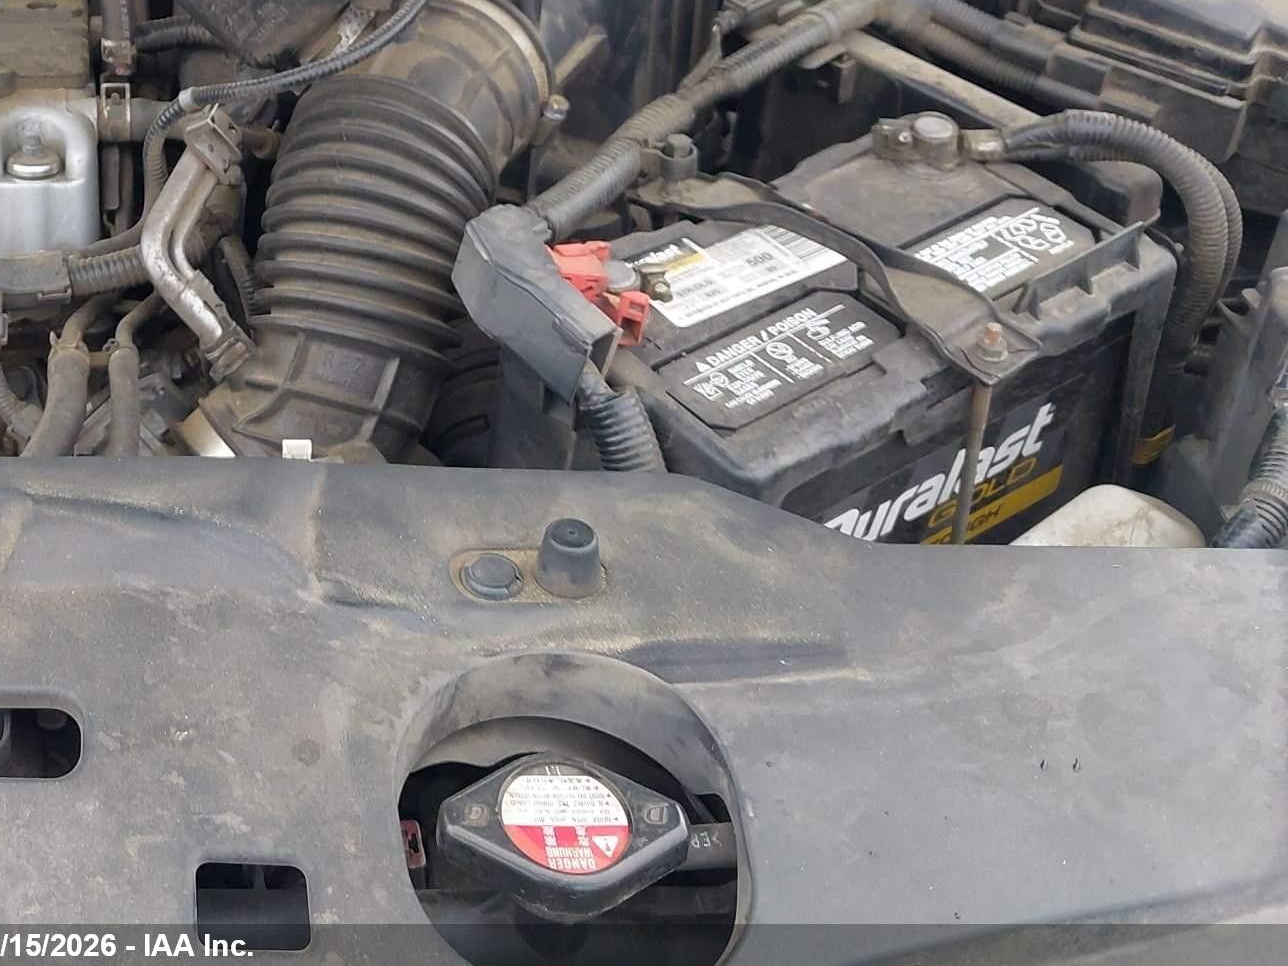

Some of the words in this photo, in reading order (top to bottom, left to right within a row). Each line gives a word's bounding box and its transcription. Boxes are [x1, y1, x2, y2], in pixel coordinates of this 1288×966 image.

[745, 252, 774, 268] 500
[705, 334, 763, 366] DANGER
[767, 307, 818, 335] POISON
[545, 846, 594, 859] WARNUNG
[548, 857, 597, 870] DANGER
